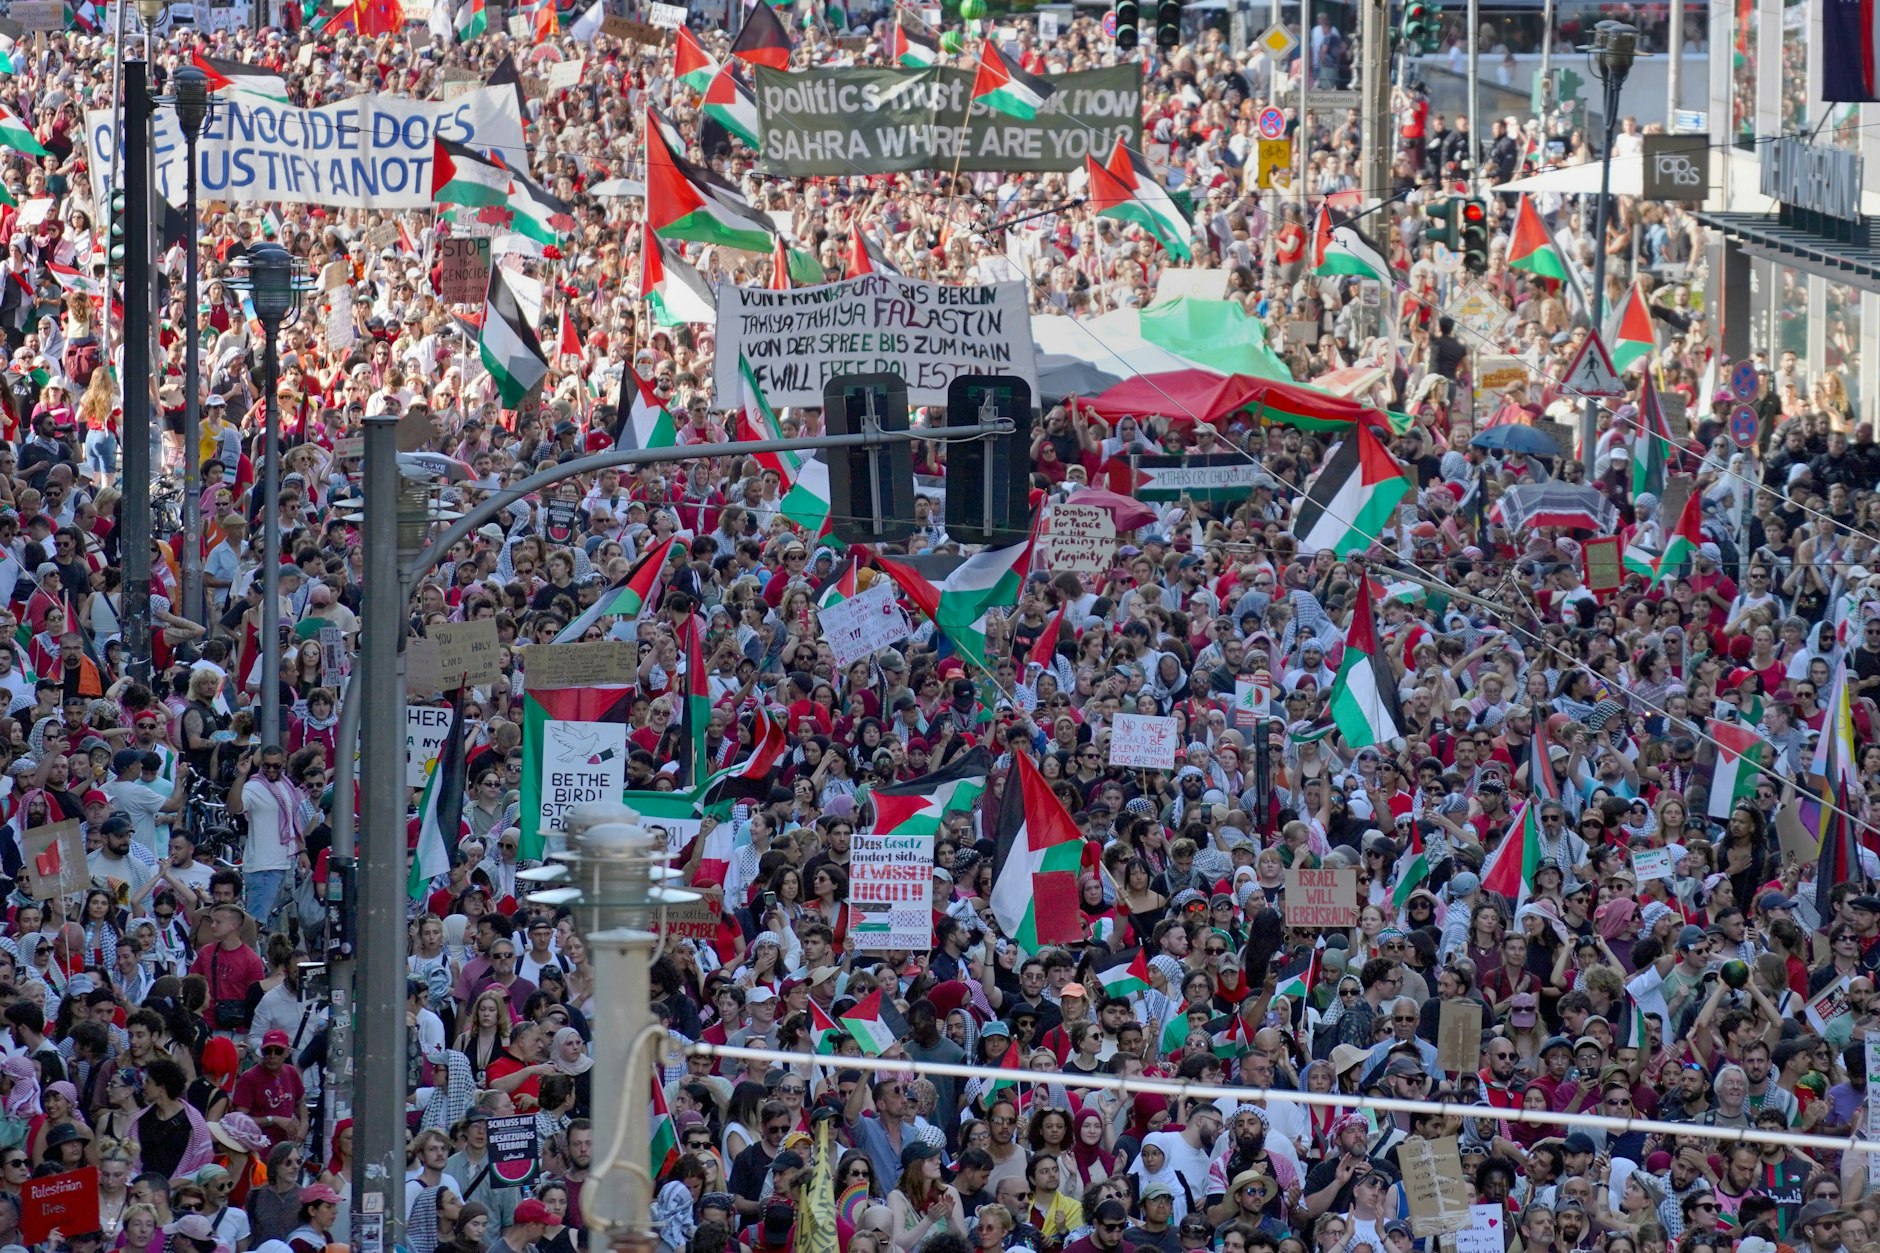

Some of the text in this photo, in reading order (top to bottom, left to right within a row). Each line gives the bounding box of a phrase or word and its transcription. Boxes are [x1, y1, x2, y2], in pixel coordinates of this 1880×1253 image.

[765, 79, 880, 120] politics
[1072, 89, 1139, 118] now
[178, 101, 359, 152] ENOCIDE
[373, 103, 475, 151] DOES
[766, 129, 871, 161] SAHRA
[978, 126, 1043, 158] ARE
[1048, 125, 1134, 159] YOU?
[184, 148, 320, 193] USTIFY
[443, 239, 489, 257] STOP
[459, 258, 472, 267] the
[442, 267, 489, 283] GENOCIDE
[898, 284, 930, 304] BIS
[938, 286, 997, 306] BERLIN
[874, 297, 1003, 337] FALASTIN
[748, 333, 1011, 362] VON DER SPREE BIS ZUM MAIN
[771, 362, 814, 393] WILL
[1156, 471, 1190, 486] MOTHERS
[1193, 470, 1207, 485] CRY
[1054, 506, 1100, 521] Bombing
[1055, 517, 1101, 529] for Peace
[1054, 549, 1103, 568] Virginity
[434, 633, 452, 646] YOU
[471, 640, 491, 652] HOLY
[441, 657, 462, 668] LAND
[1122, 720, 1163, 734] NO ONE
[1114, 734, 1162, 746] SHOULD BE
[1111, 744, 1169, 756] SILENT WHEN
[1112, 754, 1173, 767] KIDS ARE DYING
[552, 773, 611, 787] BE THE
[554, 788, 603, 803] BIRD!
[853, 836, 922, 850] Das Gesetz
[852, 851, 934, 864] ändert sich das
[849, 863, 933, 881] GEWISSEN
[1298, 870, 1338, 887] ISRAEL
[853, 882, 923, 901] NICHT!!
[1306, 888, 1335, 904] WILL
[1286, 906, 1357, 926] LEBENSRAUM
[487, 1116, 534, 1129] SCHLUSS MIT
[489, 1131, 535, 1144] BESATZUNGS
[31, 1179, 82, 1200] Palestinian
